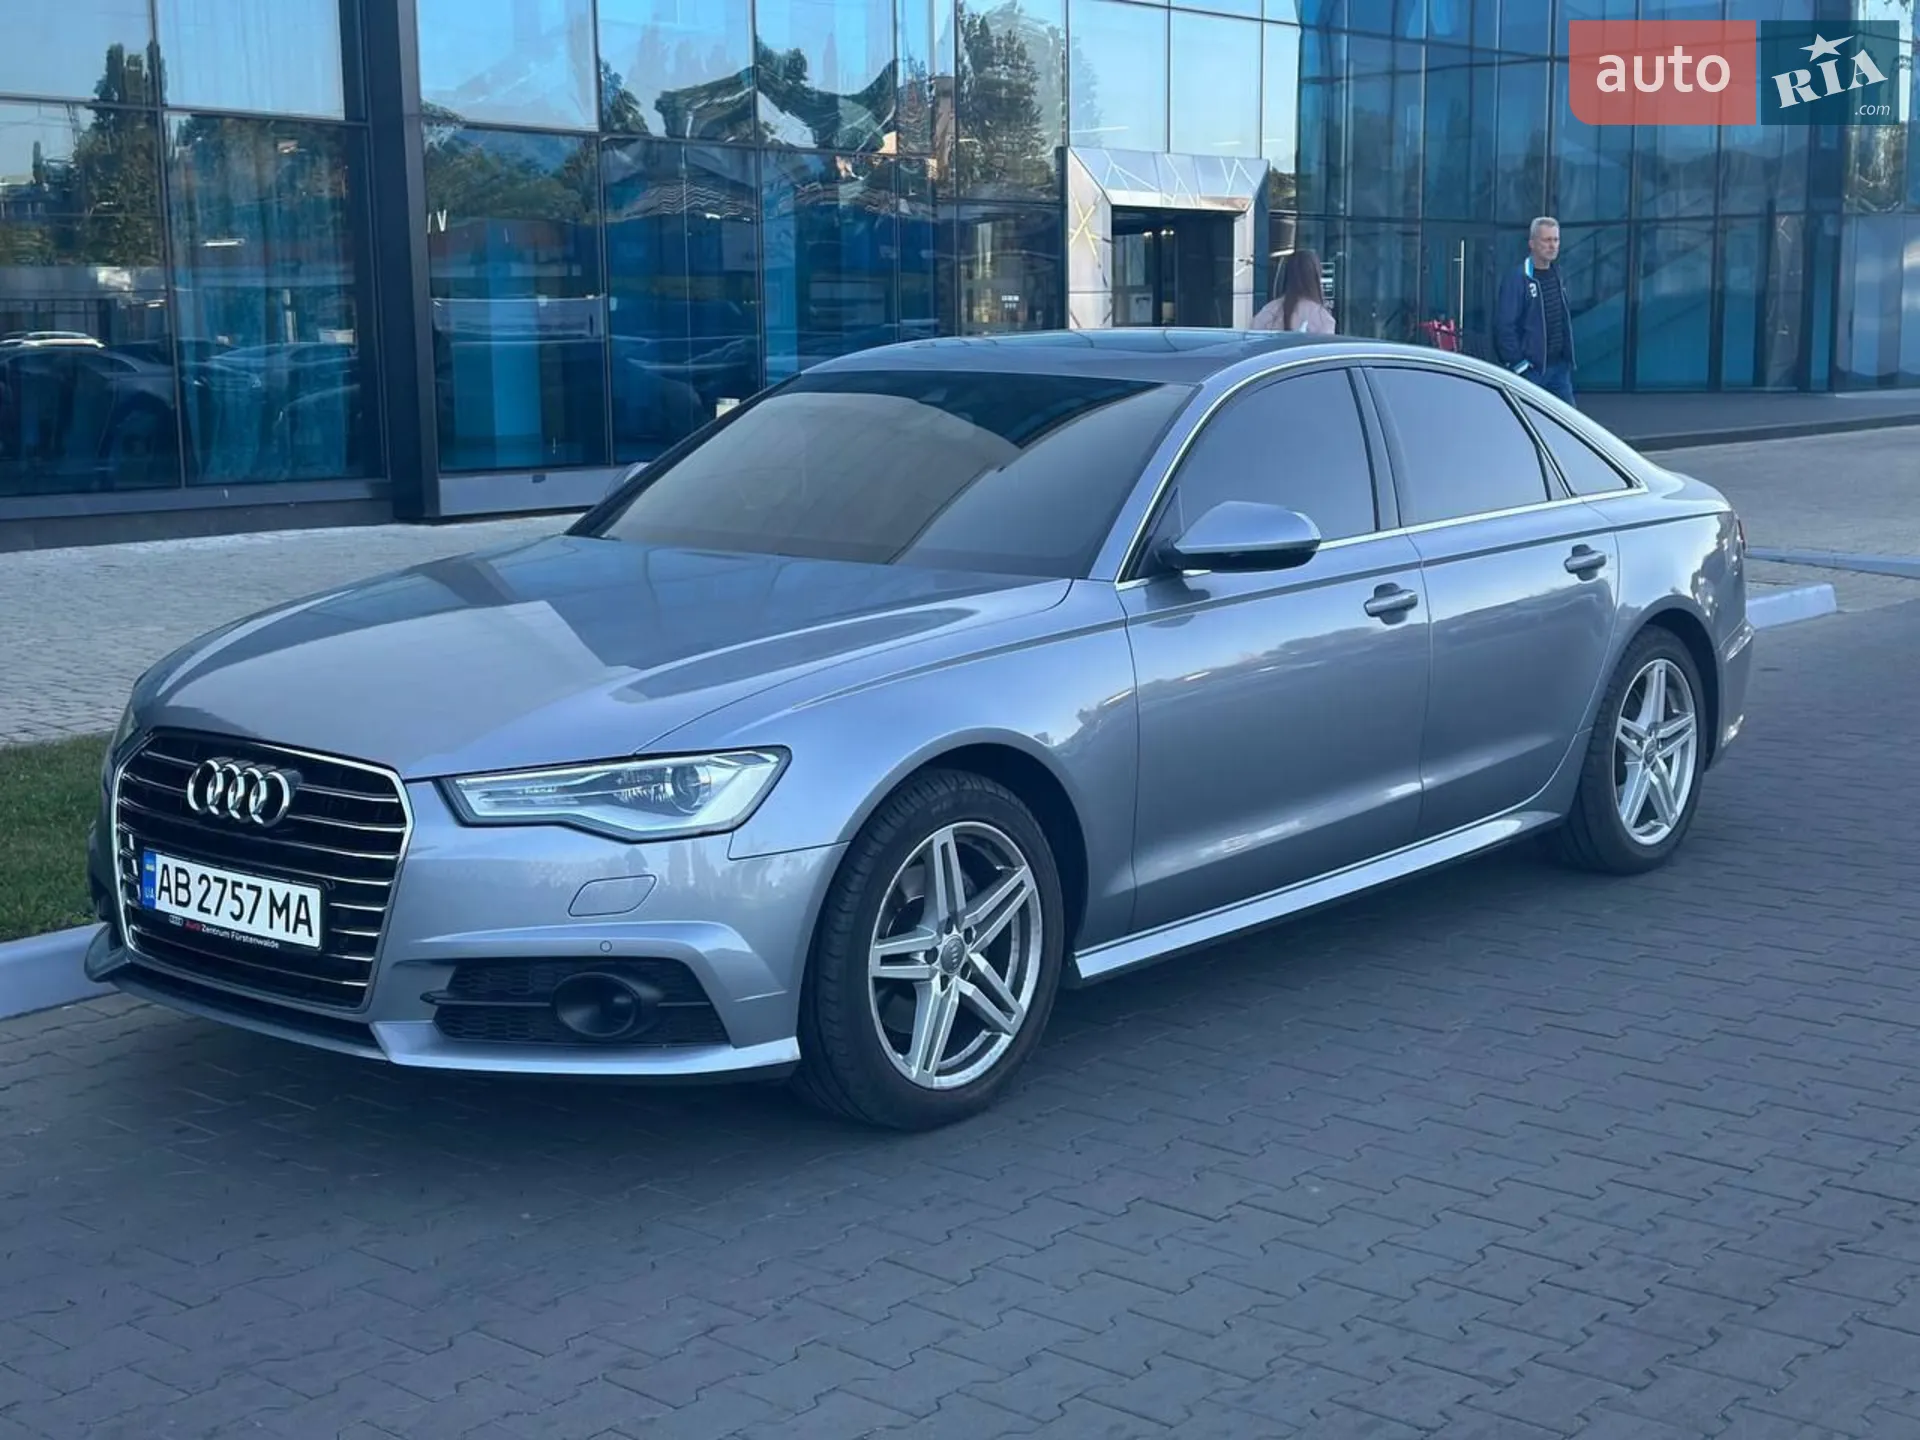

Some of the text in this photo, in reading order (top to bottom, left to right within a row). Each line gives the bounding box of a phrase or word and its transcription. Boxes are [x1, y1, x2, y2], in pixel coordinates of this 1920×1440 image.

[158, 863, 314, 938] AB 2757 MA
[201, 923, 231, 939] Zentrum
